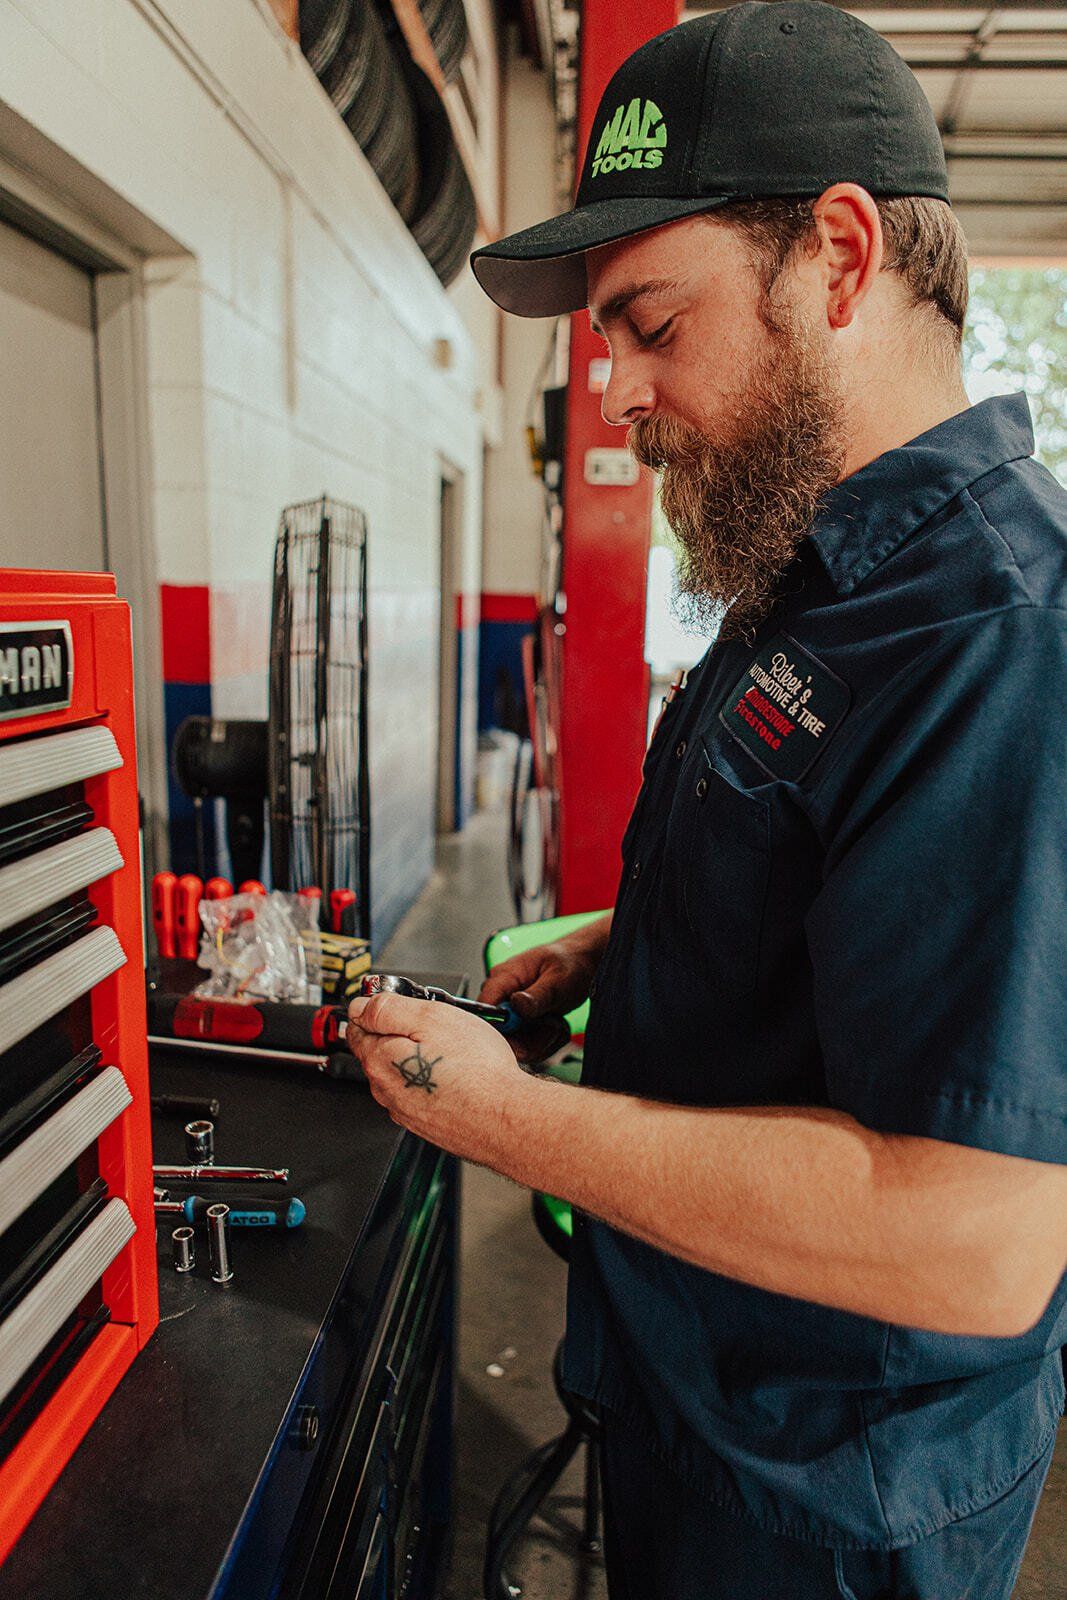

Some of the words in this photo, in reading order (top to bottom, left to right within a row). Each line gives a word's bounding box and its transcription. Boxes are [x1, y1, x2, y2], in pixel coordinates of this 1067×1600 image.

[594, 98, 667, 160] MAC
[592, 149, 664, 178] TOOLS
[749, 663, 793, 709] AUTOMOTIVE
[787, 701, 800, 717] &
[797, 707, 826, 738] TIRE
